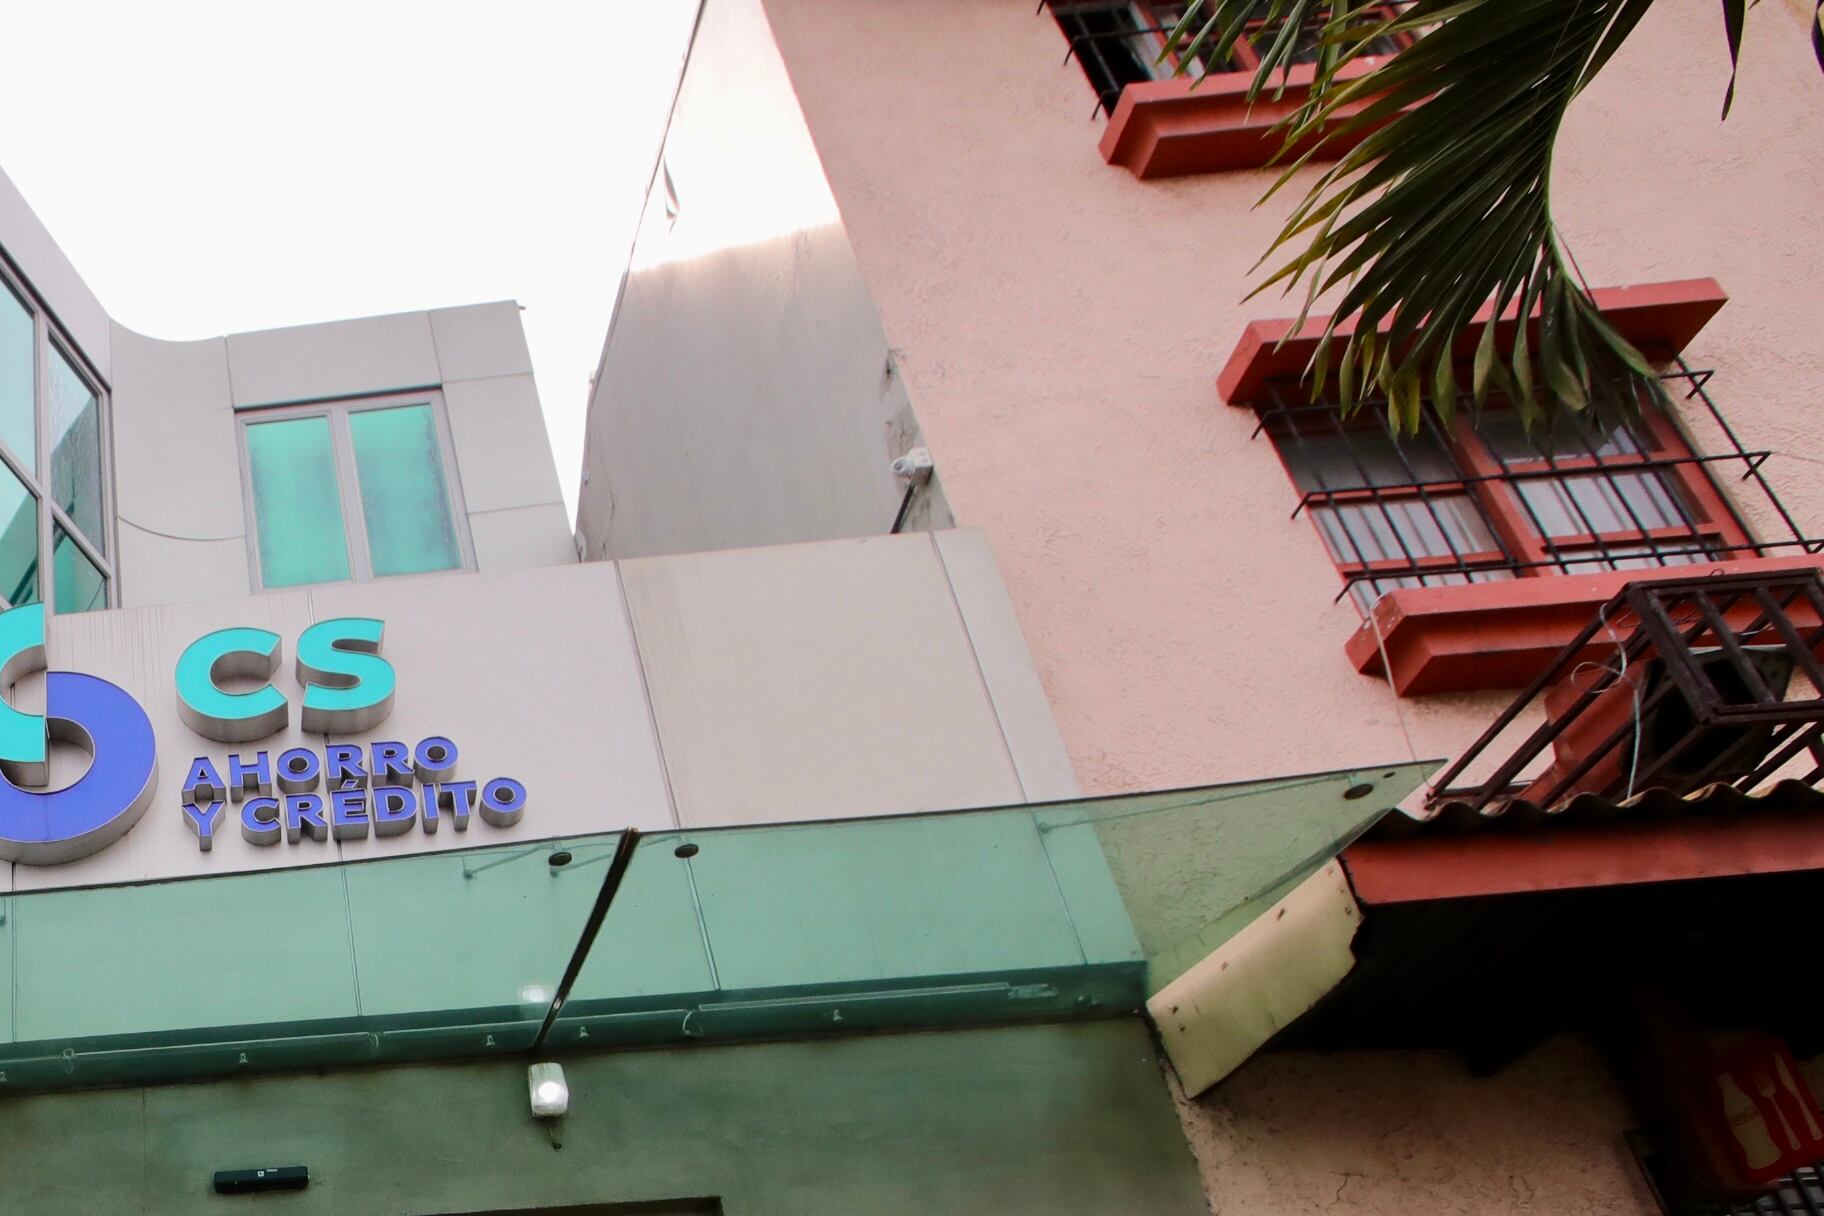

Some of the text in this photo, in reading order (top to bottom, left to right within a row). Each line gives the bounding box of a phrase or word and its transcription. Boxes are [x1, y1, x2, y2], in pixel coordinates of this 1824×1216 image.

[174, 616, 397, 738] CS
[181, 736, 460, 801] AHORRO
[182, 776, 527, 848] Y CRÉDITO
